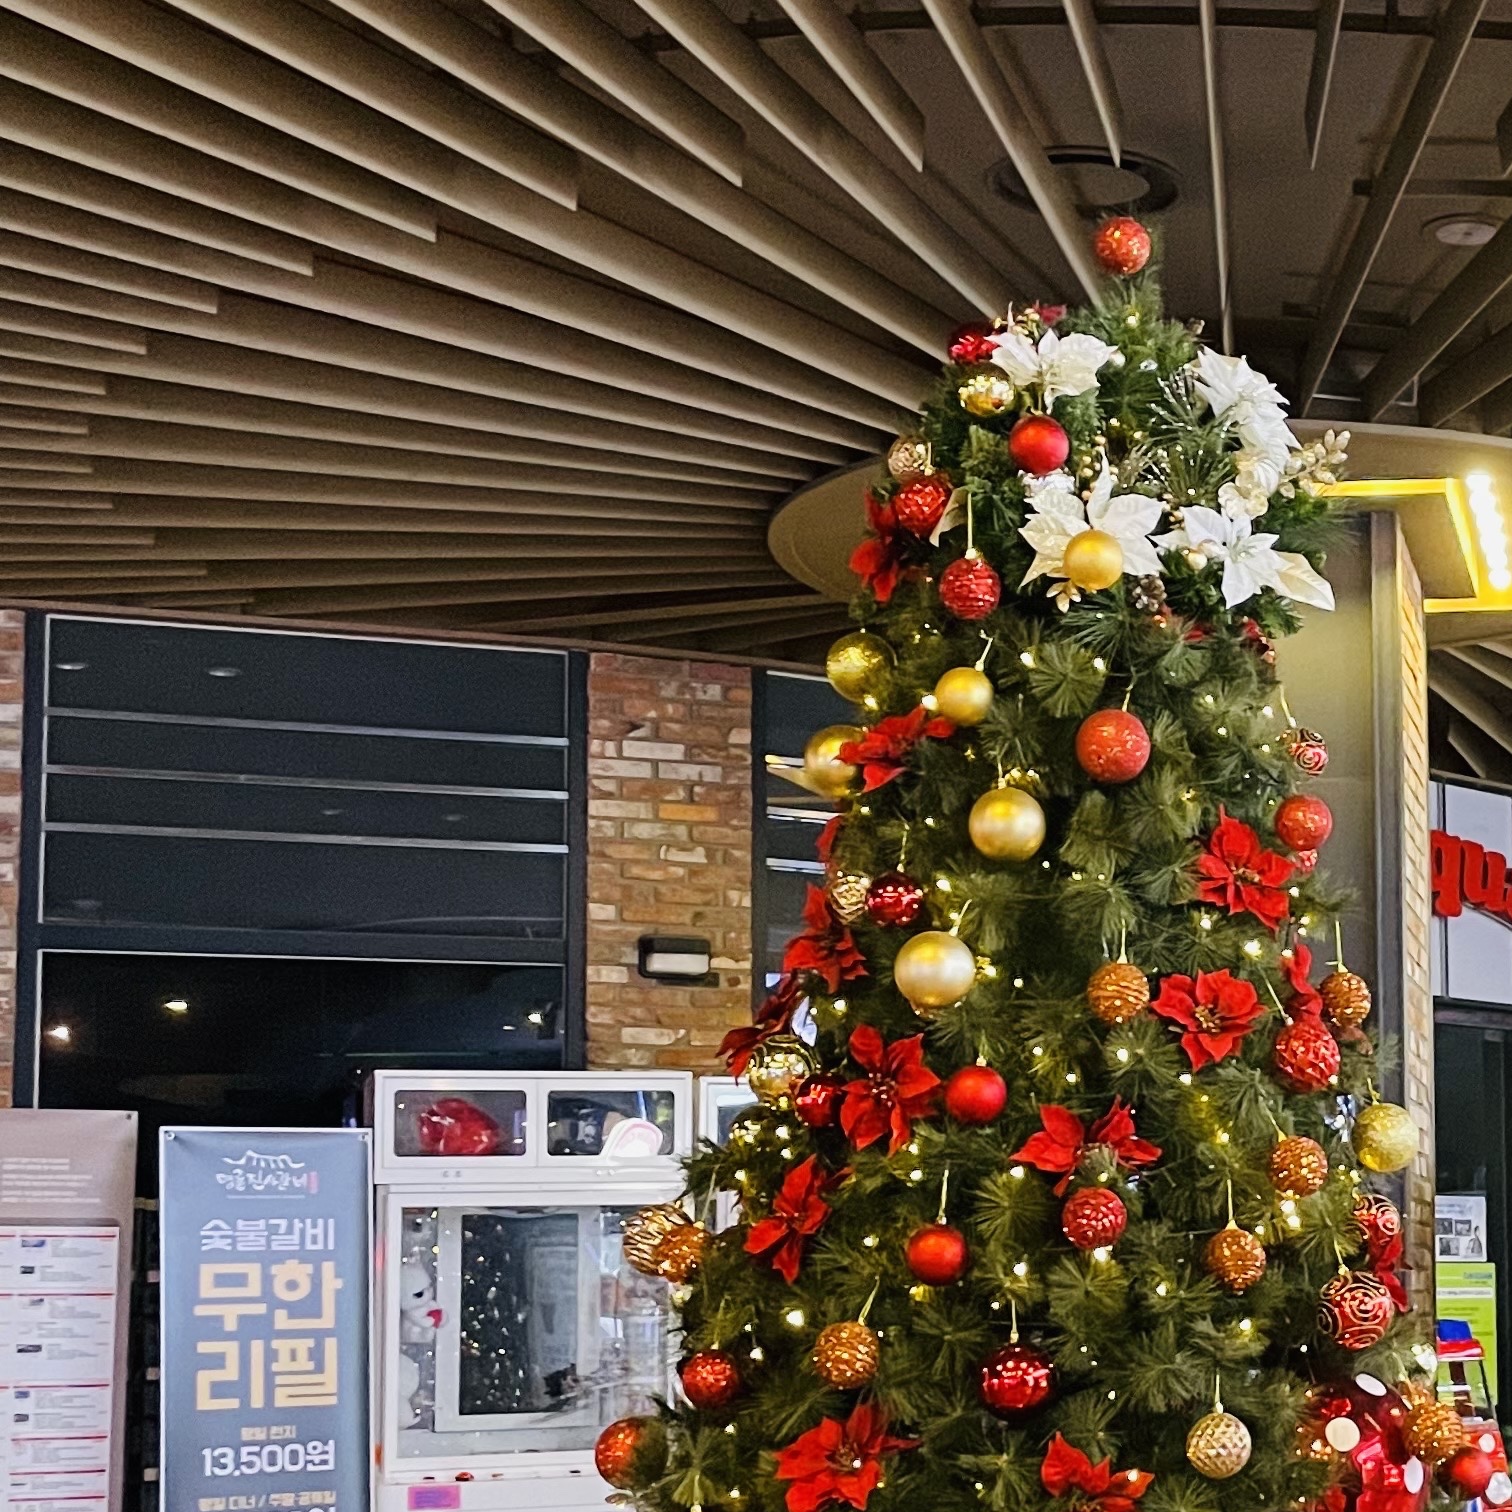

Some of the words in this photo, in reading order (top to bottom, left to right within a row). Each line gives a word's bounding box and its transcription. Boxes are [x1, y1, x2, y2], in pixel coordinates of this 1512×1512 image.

[200, 1219, 335, 1251] 숯불갈비
[193, 1259, 343, 1332] 무한
[195, 1337, 338, 1411] 리필
